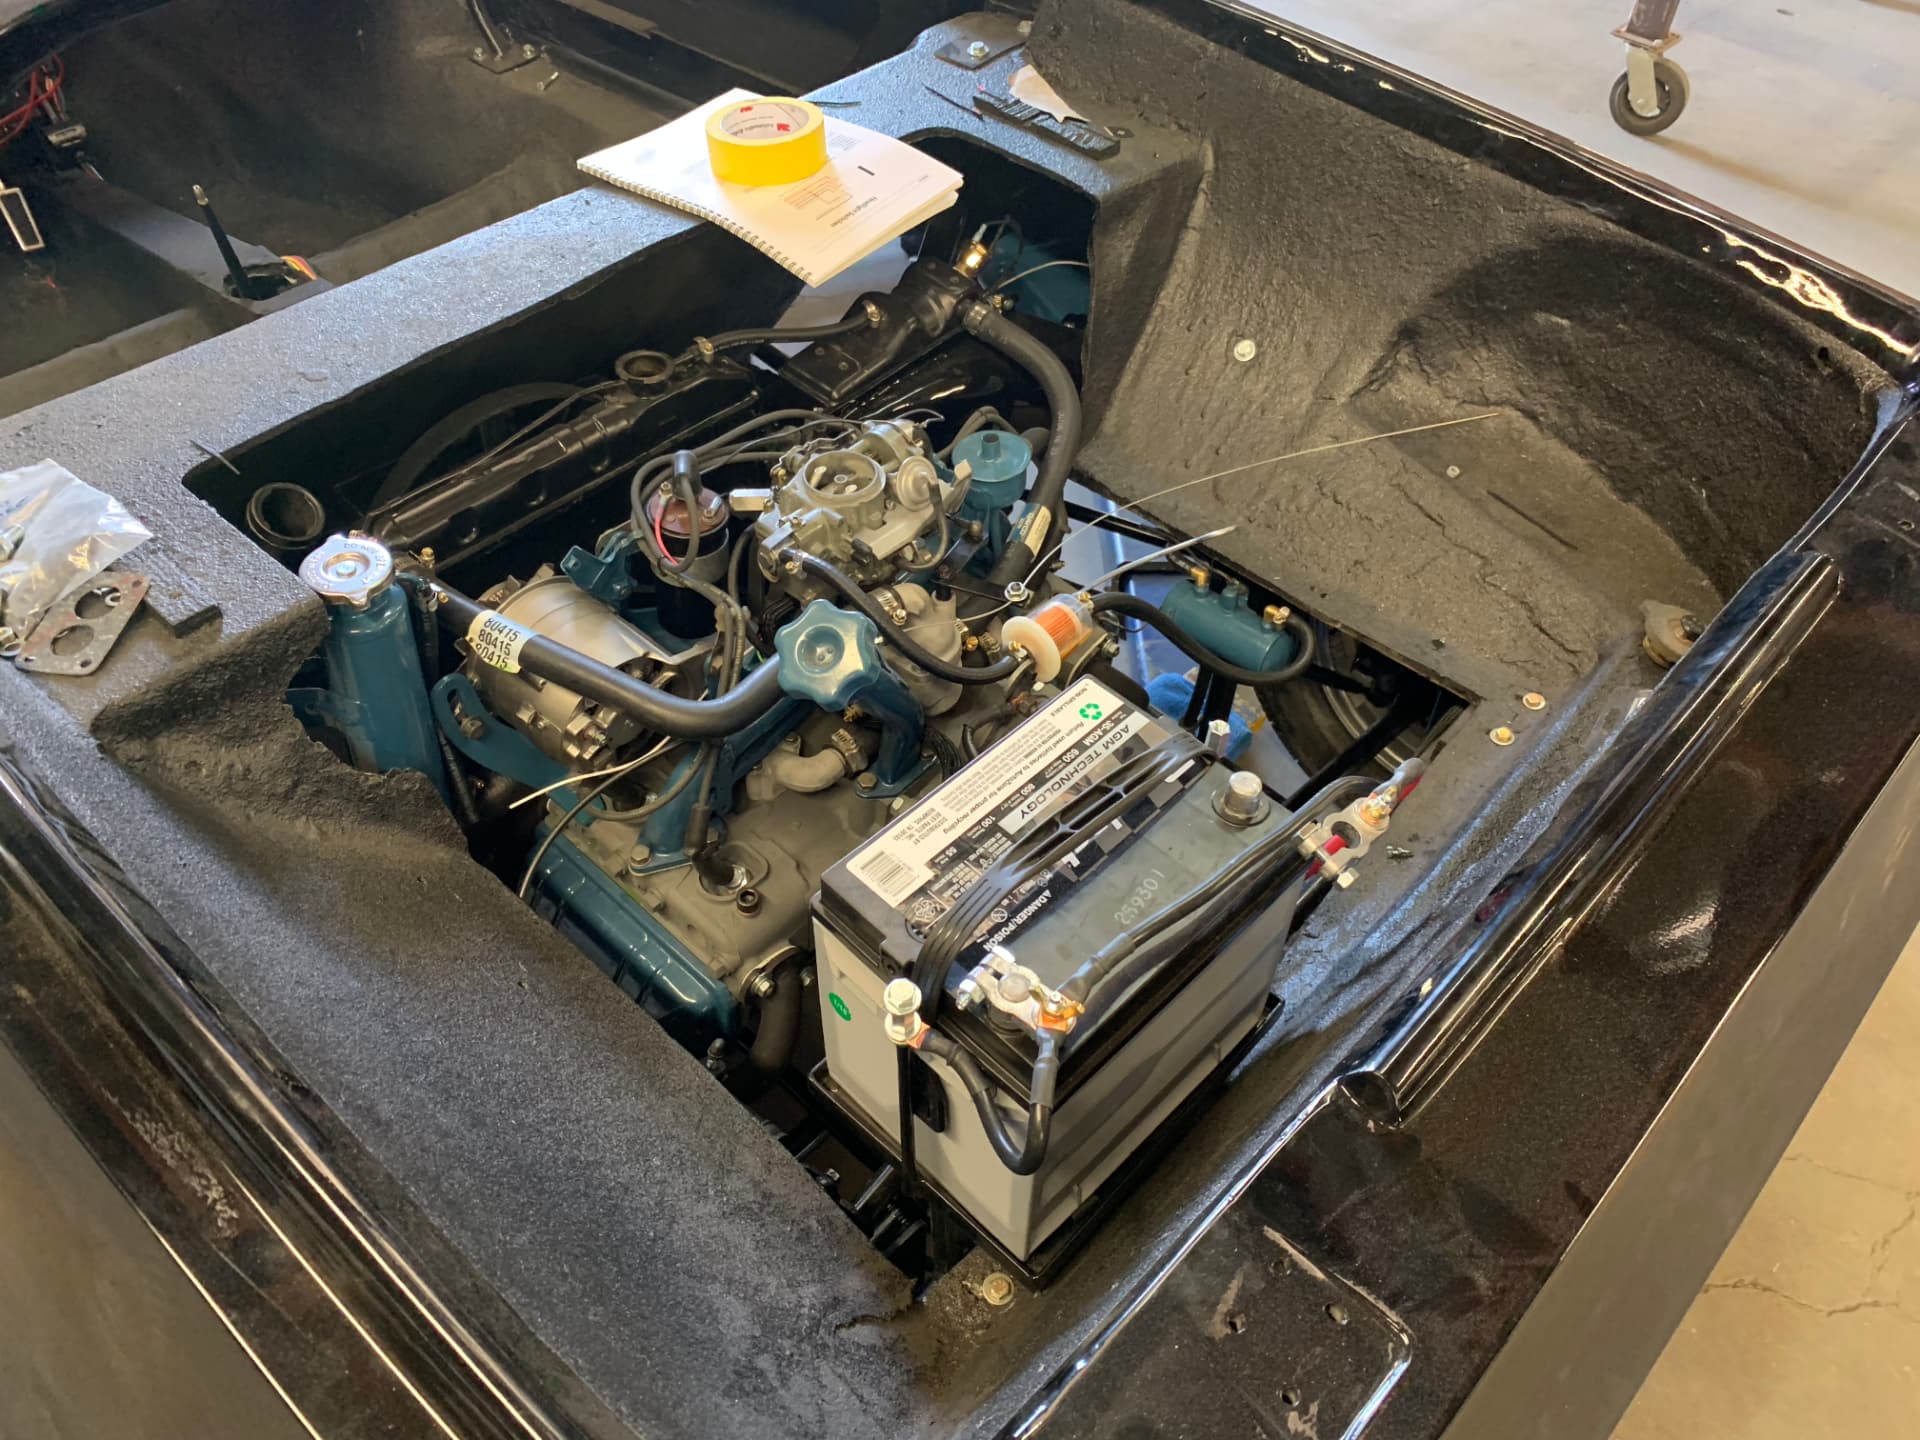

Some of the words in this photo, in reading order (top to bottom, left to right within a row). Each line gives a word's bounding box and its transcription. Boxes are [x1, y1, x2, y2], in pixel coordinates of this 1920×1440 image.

[484, 617, 520, 640] 80415
[479, 628, 511, 655] 80415
[1064, 720, 1084, 738] Return
[1081, 718, 1114, 747] 35-AGM
[1101, 723, 1131, 750] AGM
[1051, 735, 1066, 748] used
[1029, 745, 1053, 766] batteries
[1060, 746, 1080, 764] 650
[995, 768, 1024, 793] AutoZone
[1017, 747, 1102, 819] TECHNOLOGY
[967, 795, 989, 814] proper
[987, 789, 998, 799] for
[942, 810, 970, 835] recycling
[980, 813, 996, 829] 100
[982, 894, 1047, 950] DANGER/POISON
